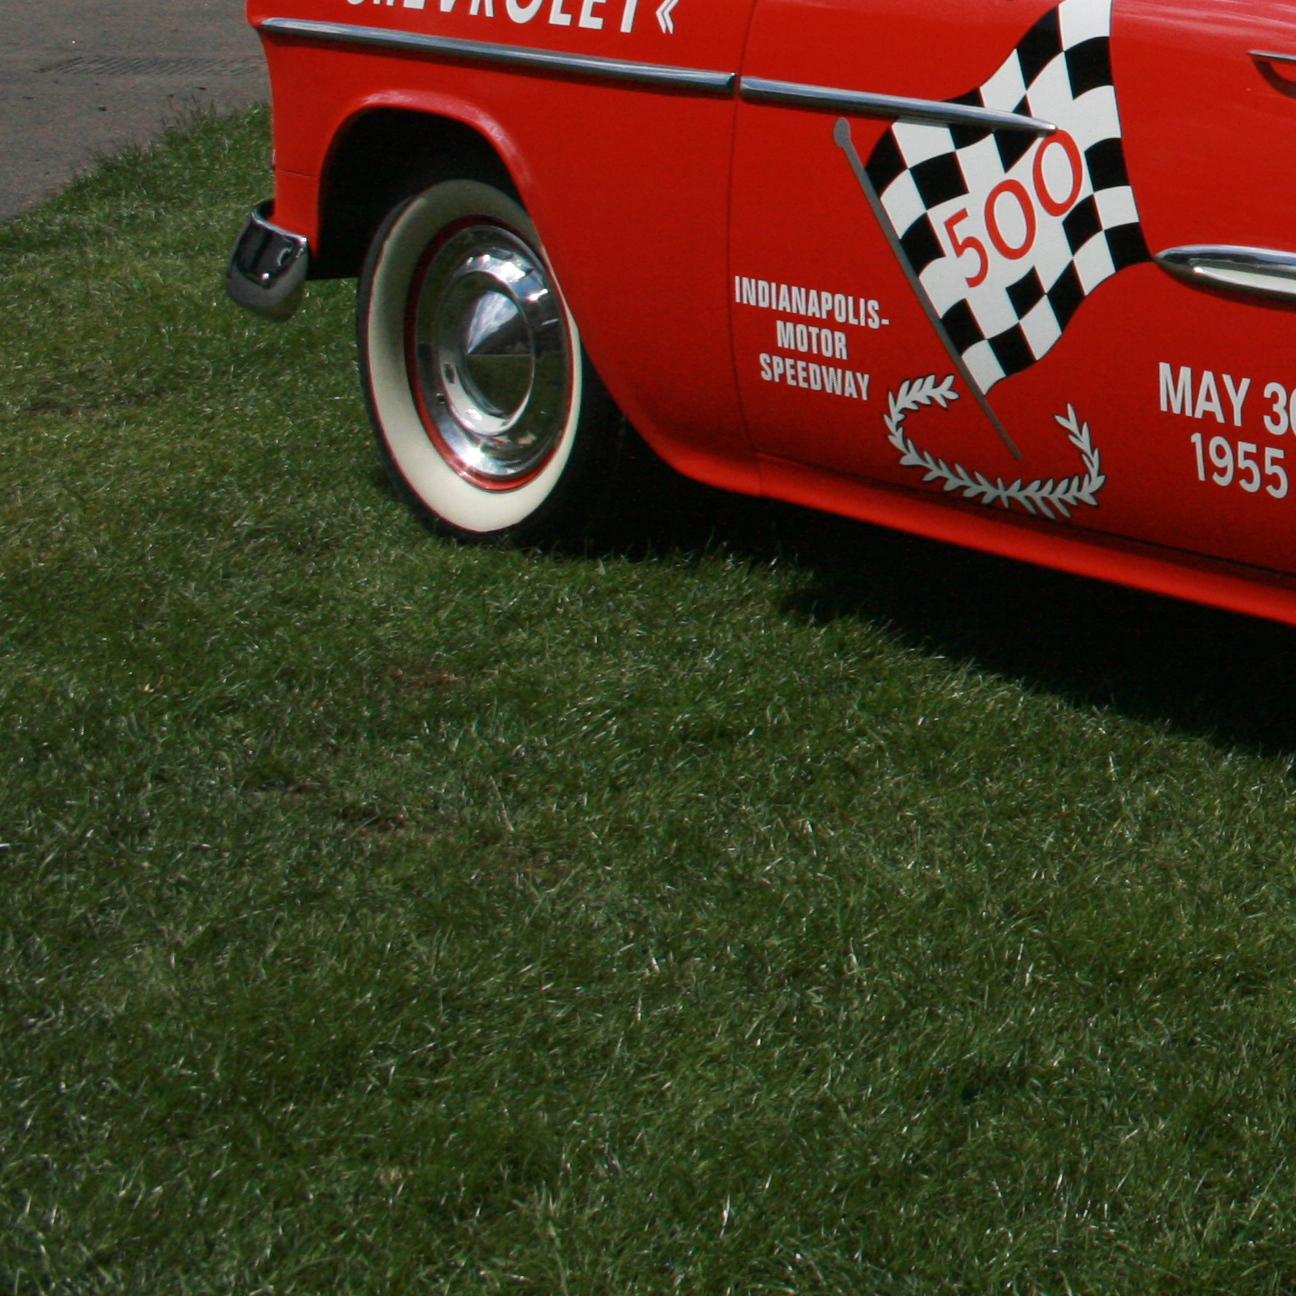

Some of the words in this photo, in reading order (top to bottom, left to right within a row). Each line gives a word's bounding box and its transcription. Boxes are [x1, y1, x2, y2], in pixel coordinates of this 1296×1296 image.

[943, 128, 1084, 288] 500
[734, 275, 890, 330] INDIANAPOLIS-
[776, 320, 848, 361] MOTOR
[759, 352, 870, 401] SPEEDWAY
[1158, 360, 1251, 427] MAY
[1190, 431, 1289, 499] 1955
